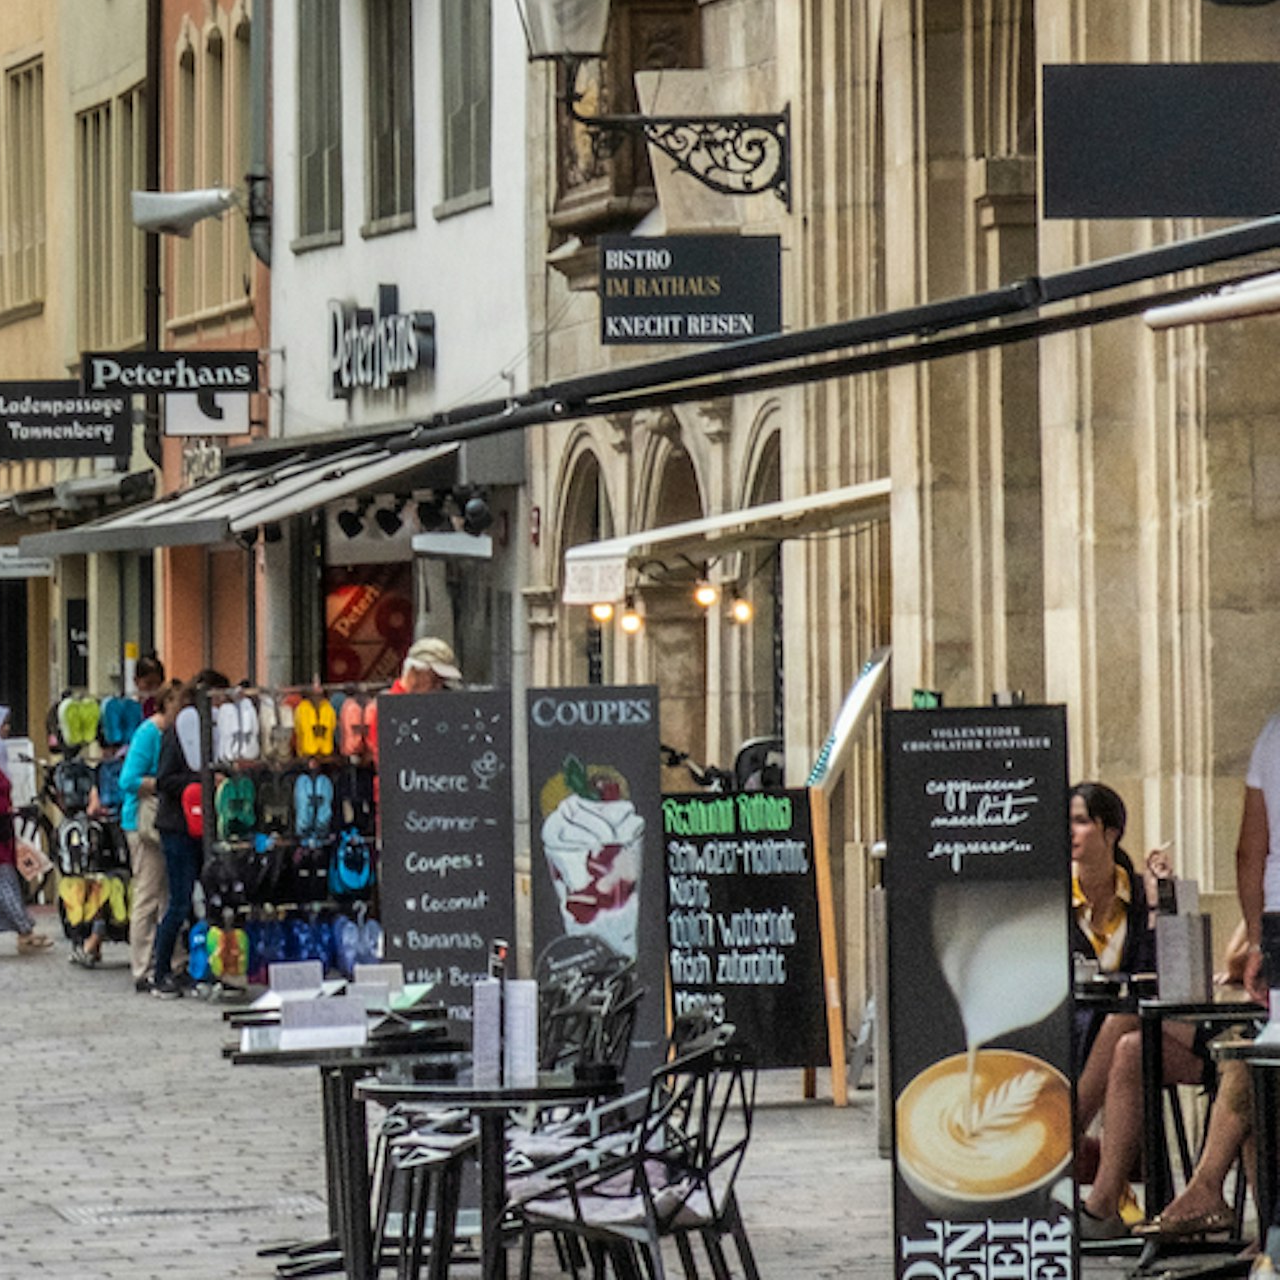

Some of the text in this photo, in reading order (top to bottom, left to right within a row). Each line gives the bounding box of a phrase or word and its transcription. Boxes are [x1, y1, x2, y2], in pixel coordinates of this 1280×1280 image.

[605, 249, 672, 270] BISTRO
[606, 275, 721, 297] IM RATHAUS
[607, 313, 754, 337] KNECHT REISEN
[91, 357, 252, 390] Peterhans
[7, 421, 114, 444] Tannenberg
[531, 697, 652, 726] COUPES
[397, 769, 468, 792] Unsere
[404, 810, 479, 833] Sommer
[421, 889, 489, 913] Coconut
[406, 929, 484, 950] Bananas
